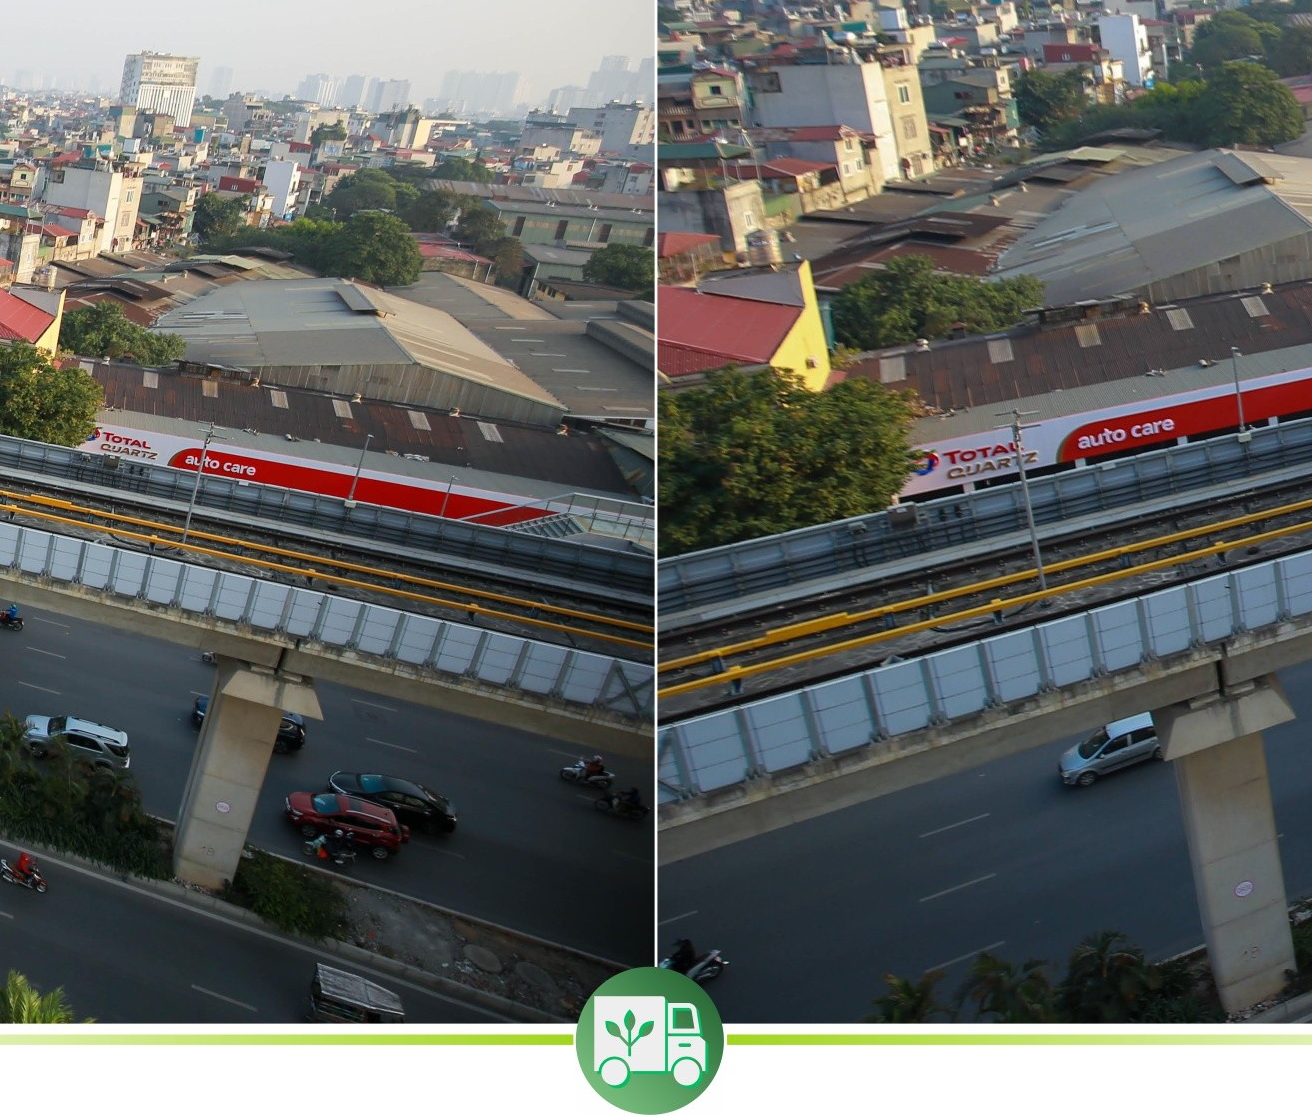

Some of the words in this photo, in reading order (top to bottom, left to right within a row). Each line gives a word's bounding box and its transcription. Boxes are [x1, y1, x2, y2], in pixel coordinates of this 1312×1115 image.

[103, 431, 152, 450] TOTAL
[1078, 427, 1126, 450] auto
[1131, 418, 1175, 438] care
[100, 443, 159, 460] QUARTZ
[943, 442, 1024, 465] TOTAL
[185, 454, 220, 469] auto
[223, 461, 256, 476] care
[946, 450, 1039, 480] QUARTZ
